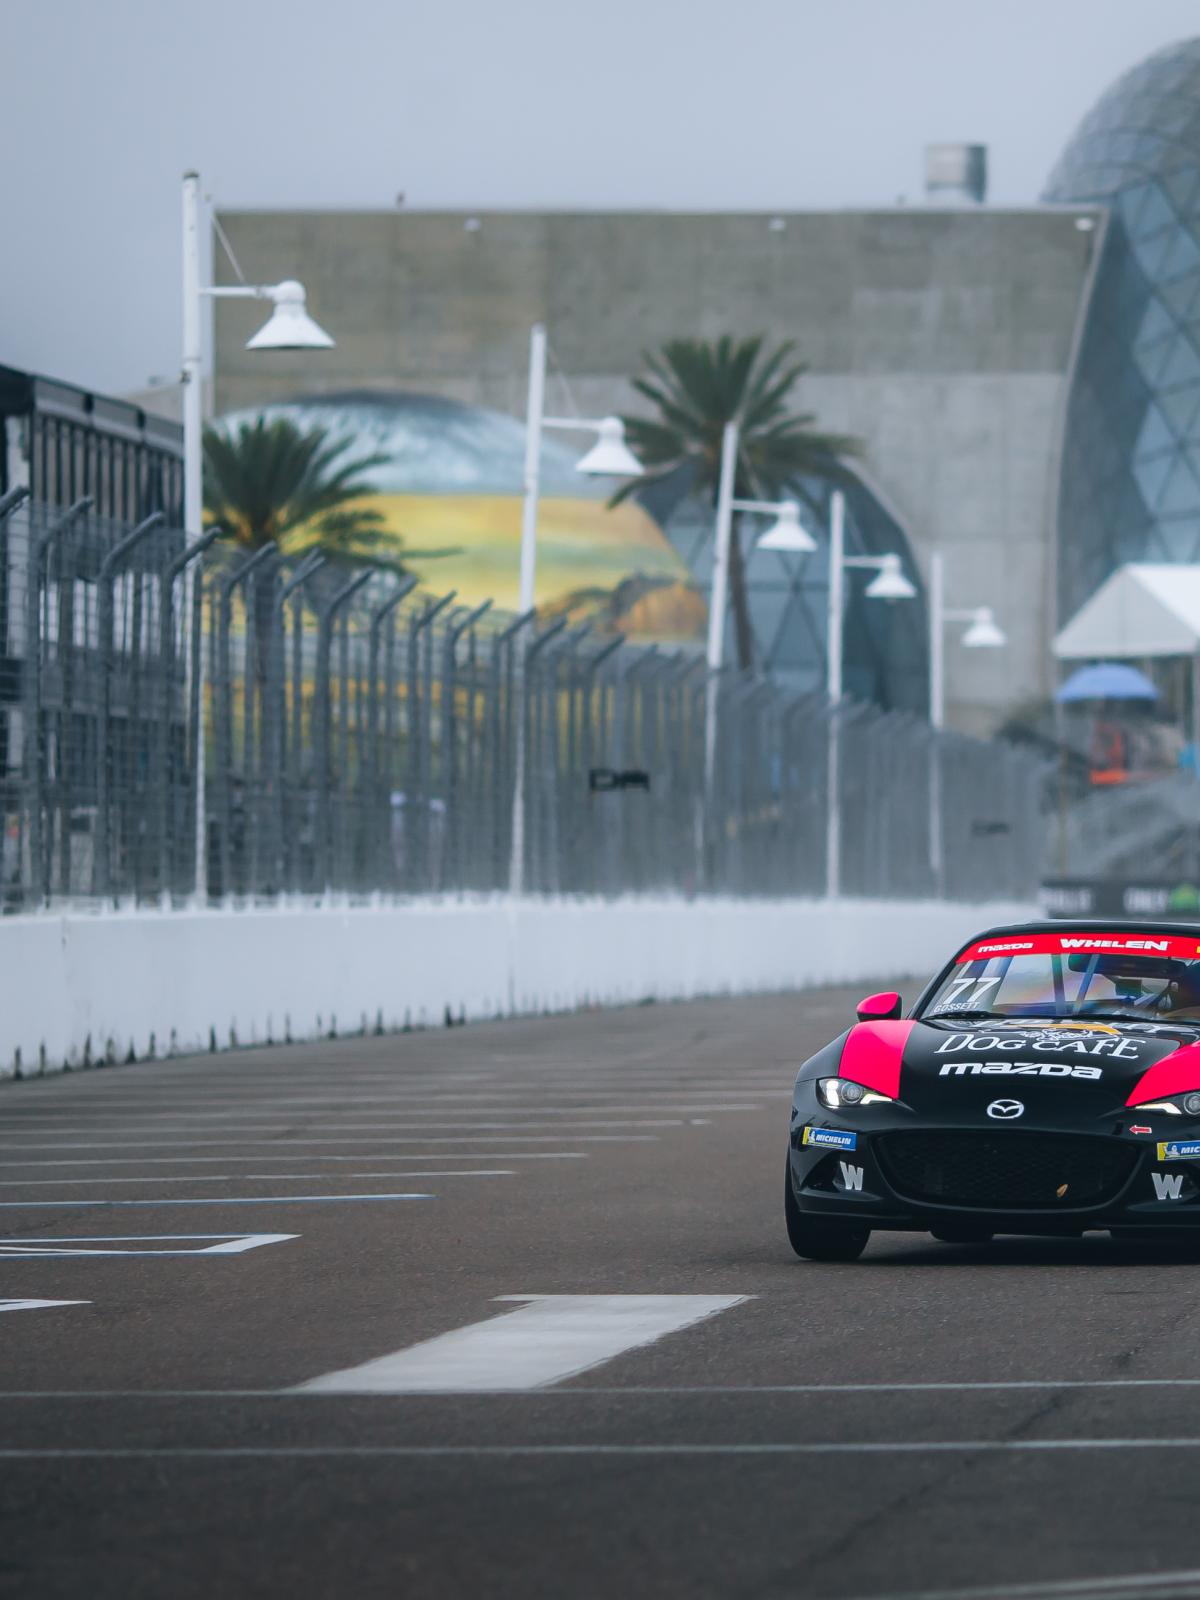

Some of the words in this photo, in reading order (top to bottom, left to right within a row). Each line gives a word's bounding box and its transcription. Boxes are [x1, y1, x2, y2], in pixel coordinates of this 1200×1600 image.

[1060, 938, 1168, 951] WHELEN
[942, 976, 1001, 1004] 77
[934, 1034, 1027, 1054] DOG
[1032, 1036, 1146, 1060] CAFE
[815, 1134, 852, 1145] MICHELIN
[839, 1160, 864, 1191] W
